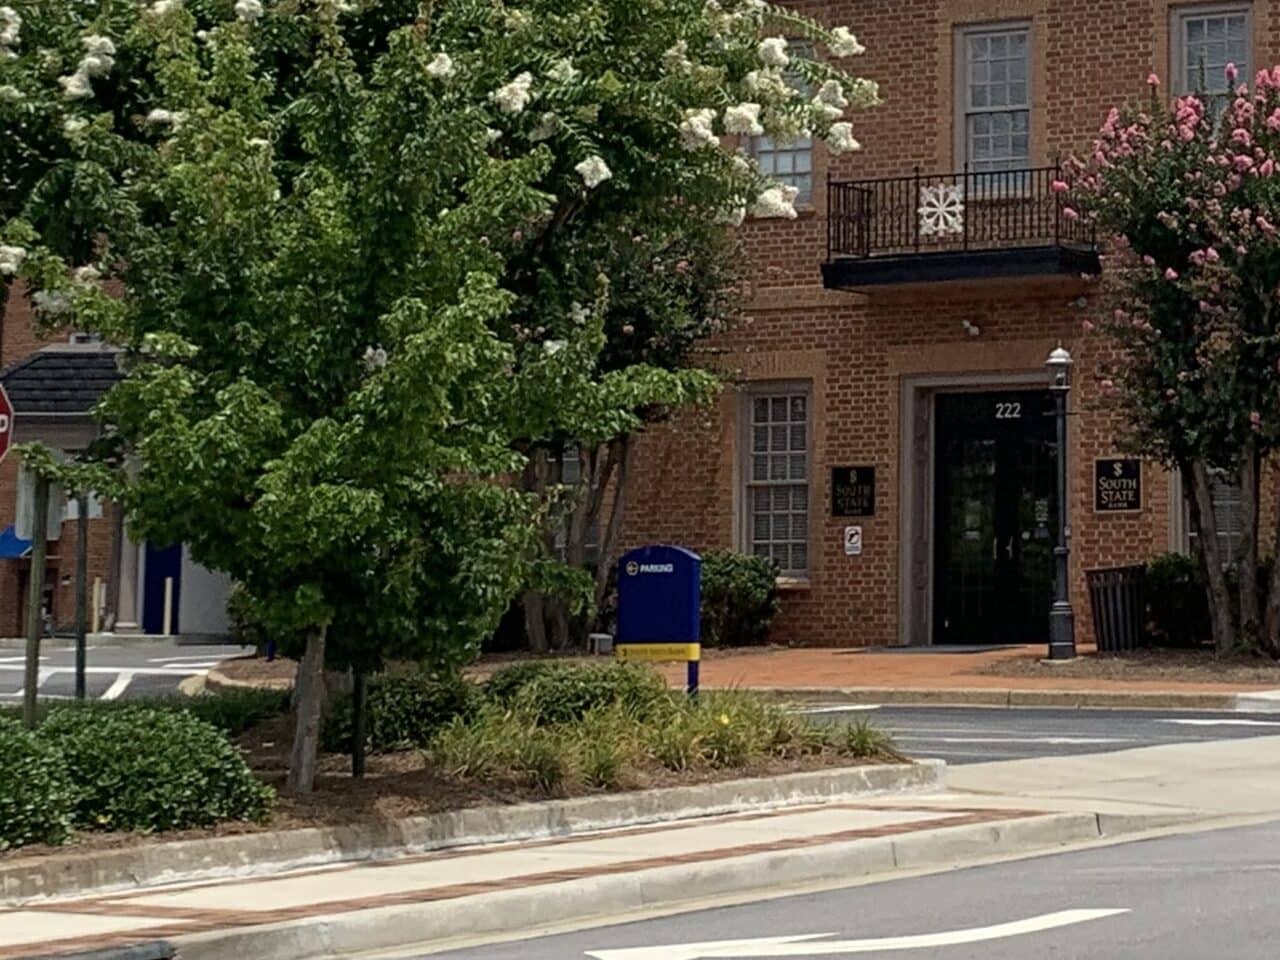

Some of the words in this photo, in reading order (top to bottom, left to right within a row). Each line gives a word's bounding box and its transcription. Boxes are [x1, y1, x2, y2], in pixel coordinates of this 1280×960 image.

[995, 402, 1021, 419] 222
[1099, 476, 1137, 490] SOUTH
[1101, 490, 1136, 504] STATE
